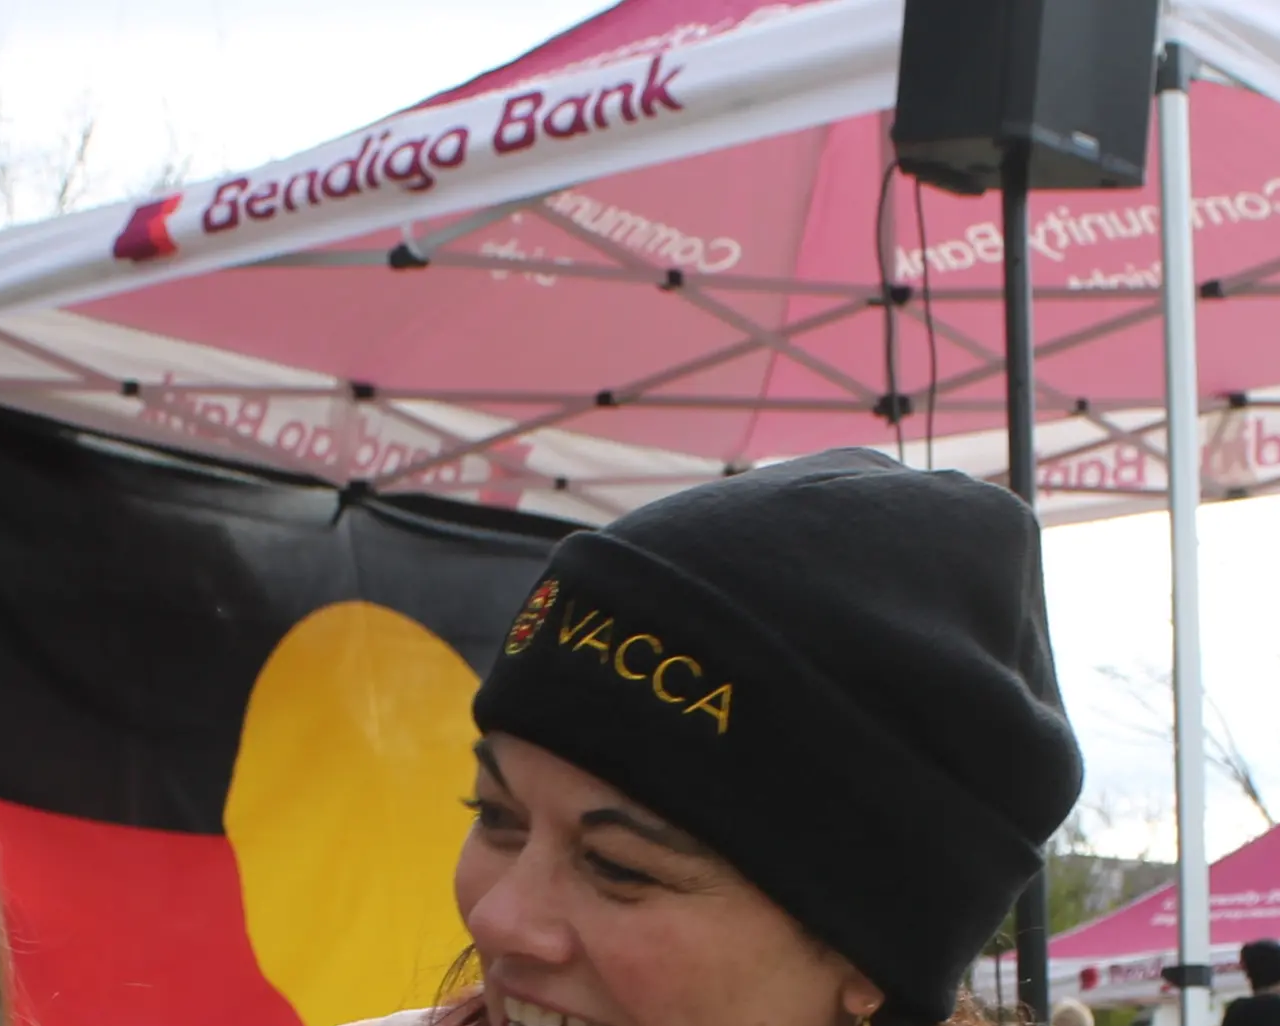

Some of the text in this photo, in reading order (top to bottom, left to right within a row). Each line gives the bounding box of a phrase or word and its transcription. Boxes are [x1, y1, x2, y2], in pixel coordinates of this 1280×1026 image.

[201, 54, 685, 236] Bendigo Bank
[558, 600, 733, 735] VACCA
